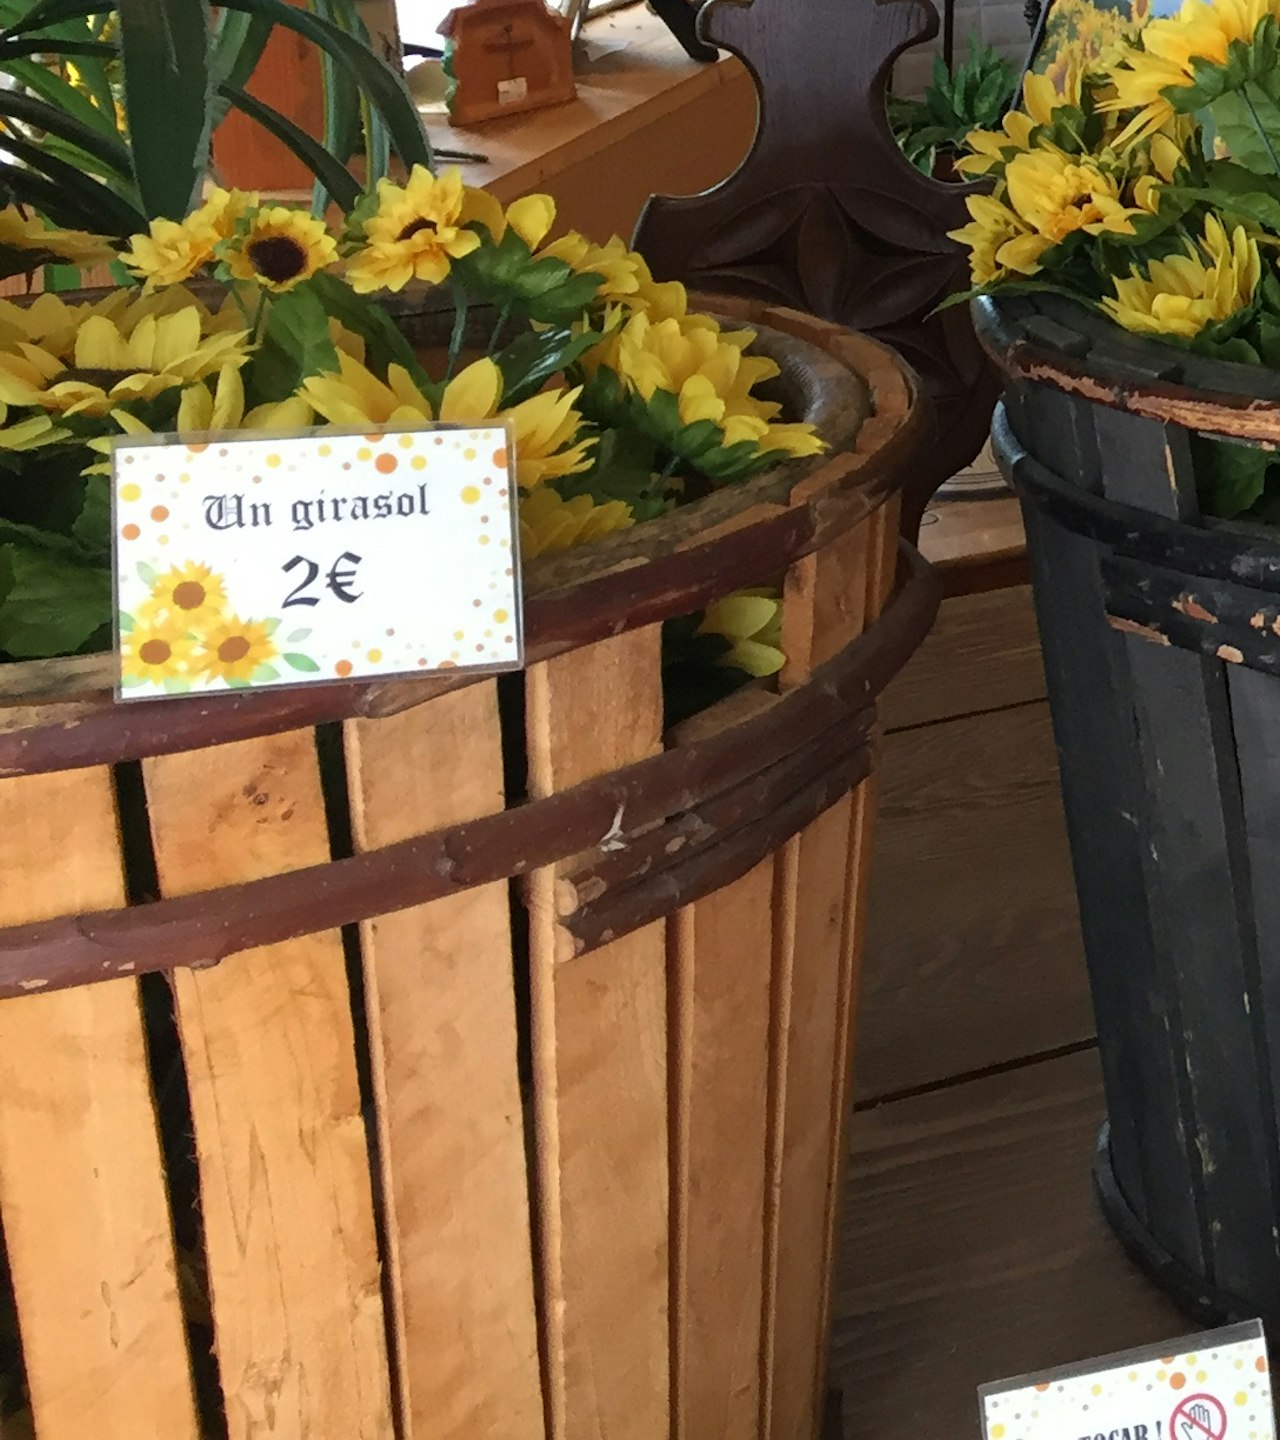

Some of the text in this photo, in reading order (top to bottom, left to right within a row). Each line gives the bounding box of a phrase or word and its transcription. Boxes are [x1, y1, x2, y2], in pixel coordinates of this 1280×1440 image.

[203, 483, 431, 531] Un girasol
[281, 551, 365, 609] 2€
